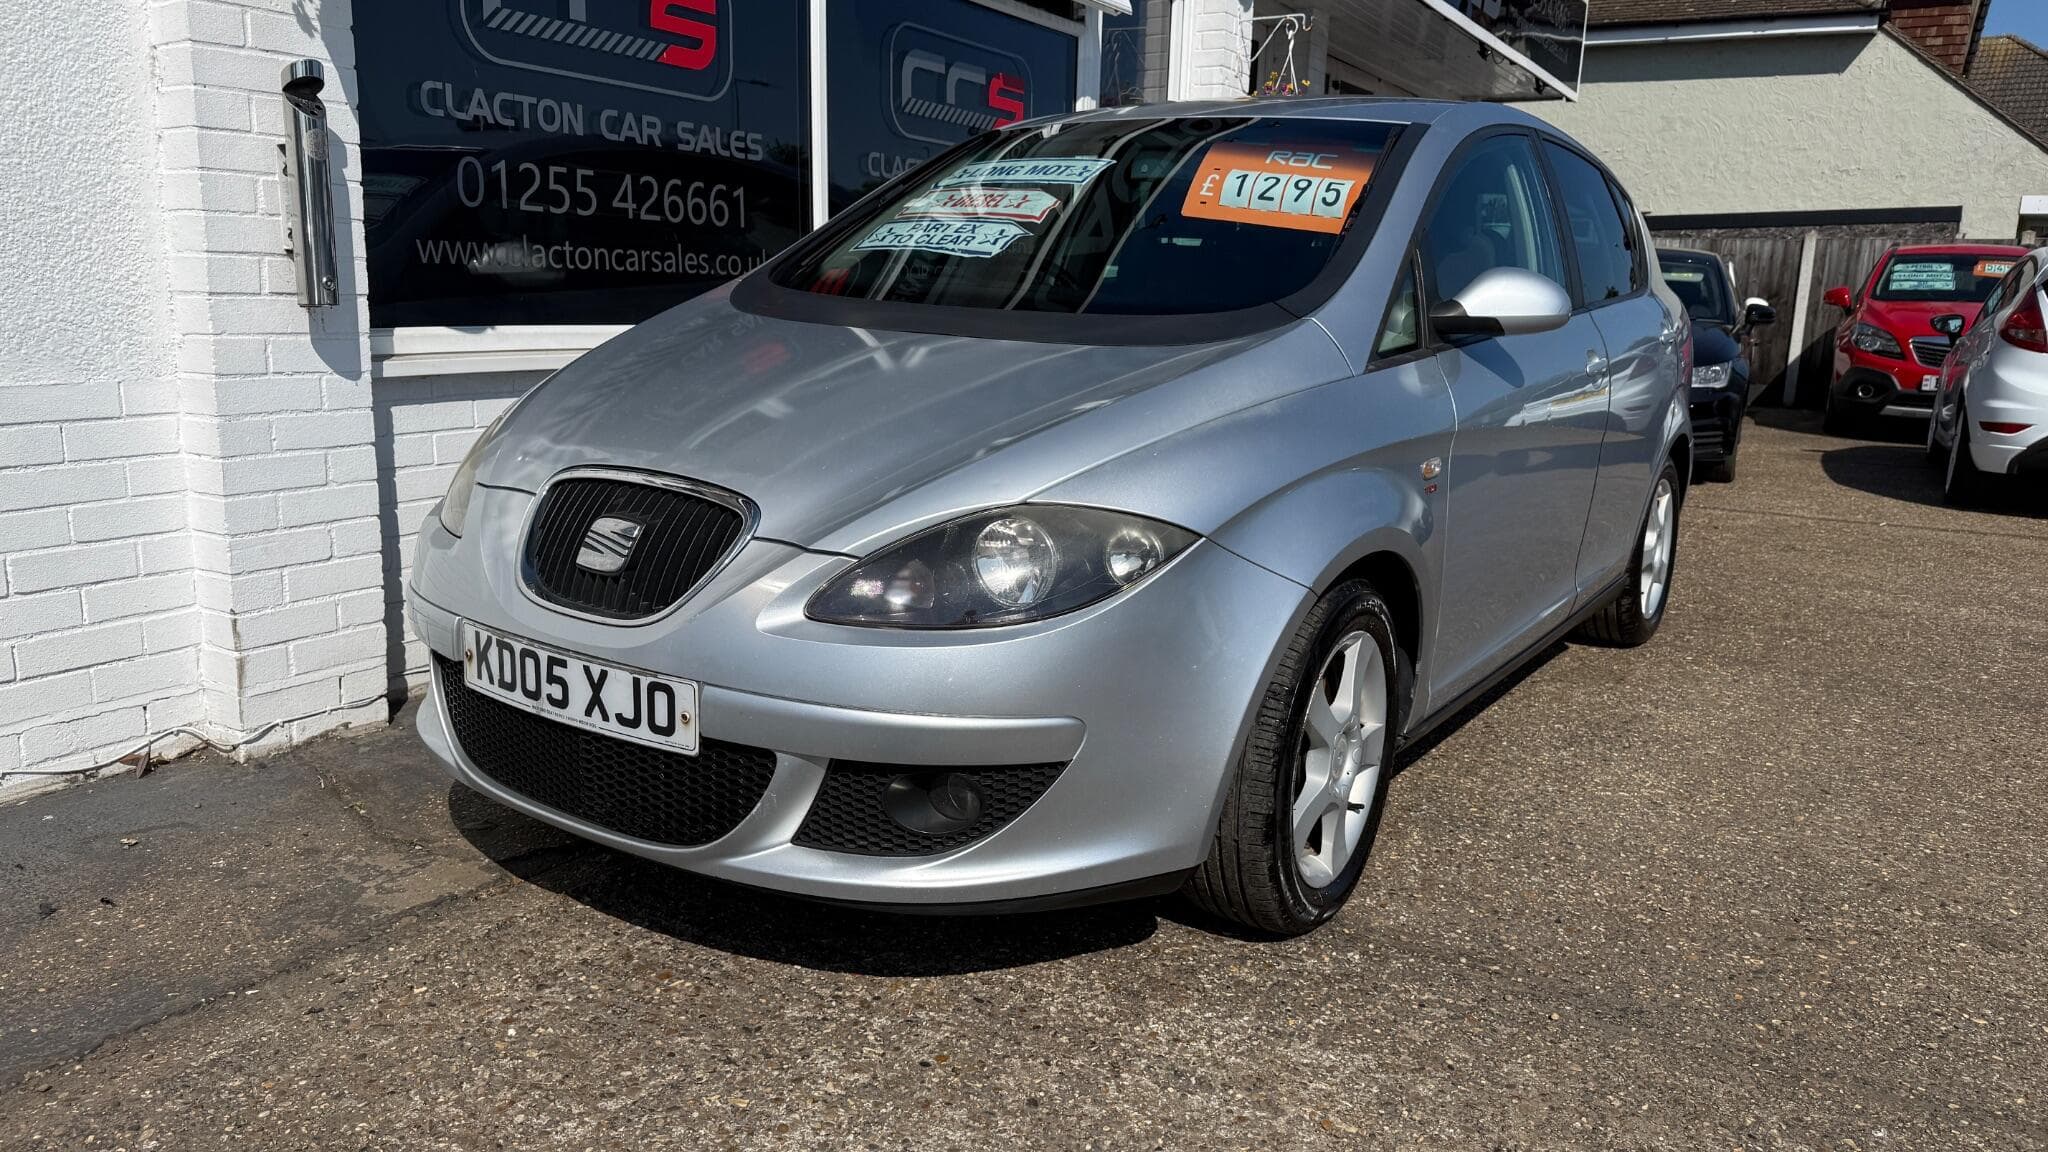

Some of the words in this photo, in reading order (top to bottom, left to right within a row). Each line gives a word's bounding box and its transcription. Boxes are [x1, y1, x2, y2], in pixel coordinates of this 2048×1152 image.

[420, 80, 583, 136] CLACTON
[600, 109, 662, 147] CAR
[676, 121, 764, 162] SALES
[969, 164, 1021, 178] LONG
[1023, 164, 1071, 177] MOT
[457, 156, 597, 216] 01255
[612, 174, 745, 228] 426661
[951, 194, 1007, 208] DIESEL
[1236, 173, 1345, 207] 1295
[889, 234, 912, 245] TO
[914, 234, 976, 247] CLEAR
[907, 223, 954, 234] PART
[953, 224, 984, 235] EX
[474, 630, 569, 710] KD05
[583, 665, 676, 738] XJO
